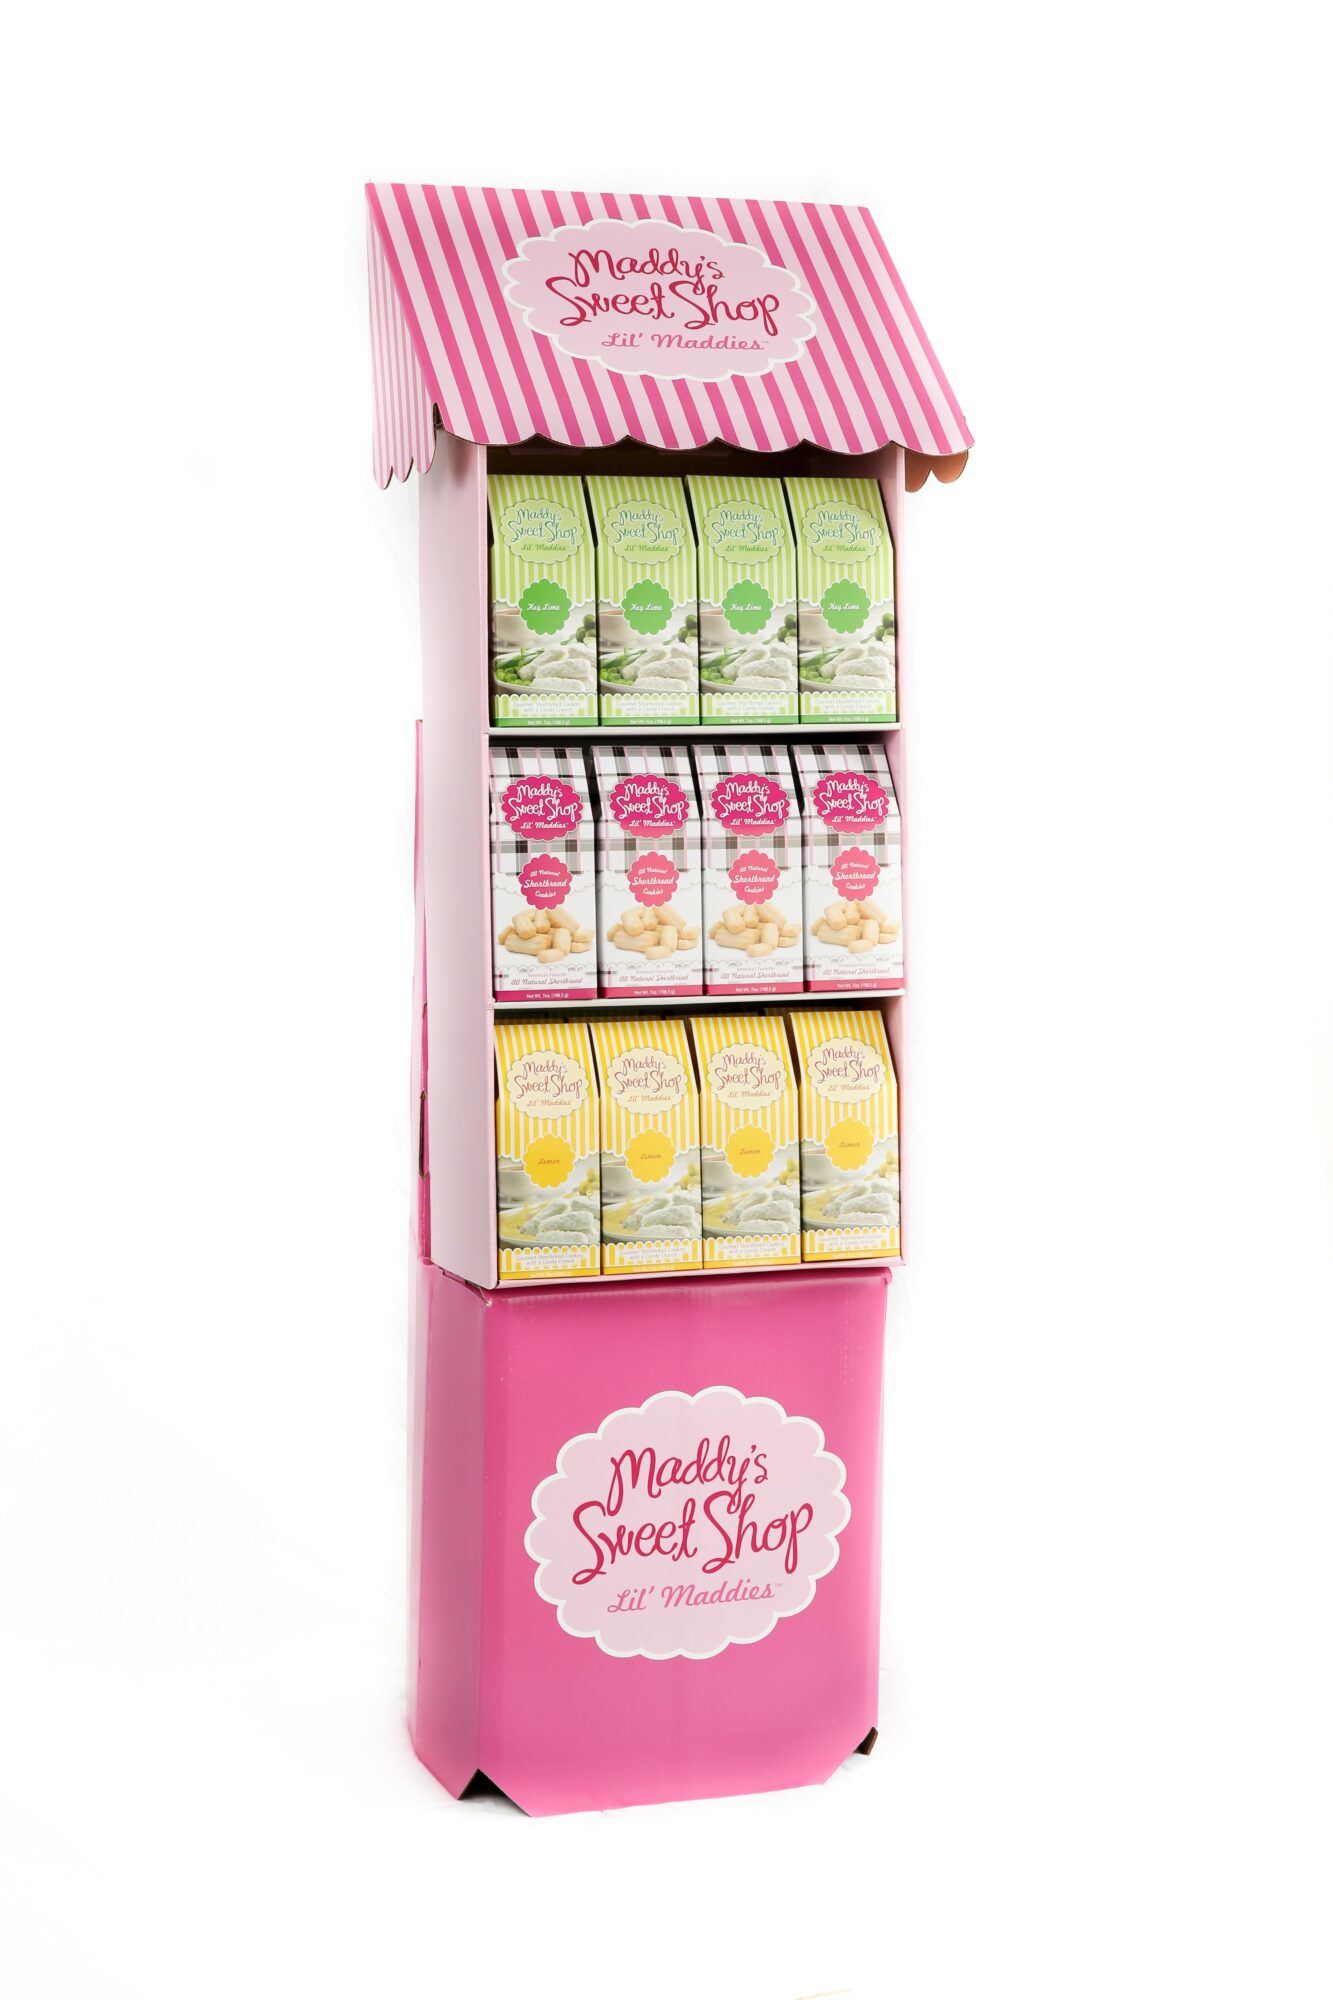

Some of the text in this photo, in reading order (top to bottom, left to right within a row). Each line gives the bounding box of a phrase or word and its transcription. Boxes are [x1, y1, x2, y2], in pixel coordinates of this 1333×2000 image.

[568, 247, 724, 295] Maddy's
[545, 276, 779, 337] Sweet Shop
[601, 332, 644, 348] Lil'
[517, 508, 562, 527] Maddy's
[620, 509, 664, 528] Maddy's
[720, 510, 763, 528] Maddy's
[818, 509, 861, 528] Maddy's
[508, 521, 577, 545] Sweet Shop
[611, 522, 678, 546] Sweet Shop
[712, 522, 778, 546] Sweet Shop
[810, 522, 876, 547] Sweet Shop
[527, 603, 541, 612] Key
[630, 603, 644, 612] Key
[730, 603, 744, 612] Key
[828, 603, 842, 612] Key
[517, 784, 563, 804] Maddy's
[625, 782, 669, 802] Maddy's
[726, 781, 770, 801] Maddy's
[827, 779, 869, 798] Maddy's
[508, 798, 578, 822] Sweet Shop
[616, 796, 684, 820] Sweet Shop
[718, 795, 785, 818] Sweet Shop
[819, 793, 884, 816] Sweet Shop
[524, 879, 568, 888] Shortbread
[632, 877, 674, 886] Shortbread
[734, 875, 775, 884] Shortbread
[836, 872, 876, 880] Shortbread
[623, 1056, 666, 1076] Maddy's
[723, 1052, 766, 1072] Maddy's
[822, 1046, 864, 1066] Maddy's
[523, 1060, 568, 1080] Maddy's
[715, 1066, 781, 1090] Sweet Shop
[815, 1060, 880, 1084] Sweet Shop
[514, 1074, 582, 1099] Sweet Shop
[615, 1070, 681, 1094] Sweet Shop
[606, 1434, 769, 1517] Maddy's
[572, 1490, 814, 1585] Sweet Shop
[607, 1586, 655, 1614] Lil'
